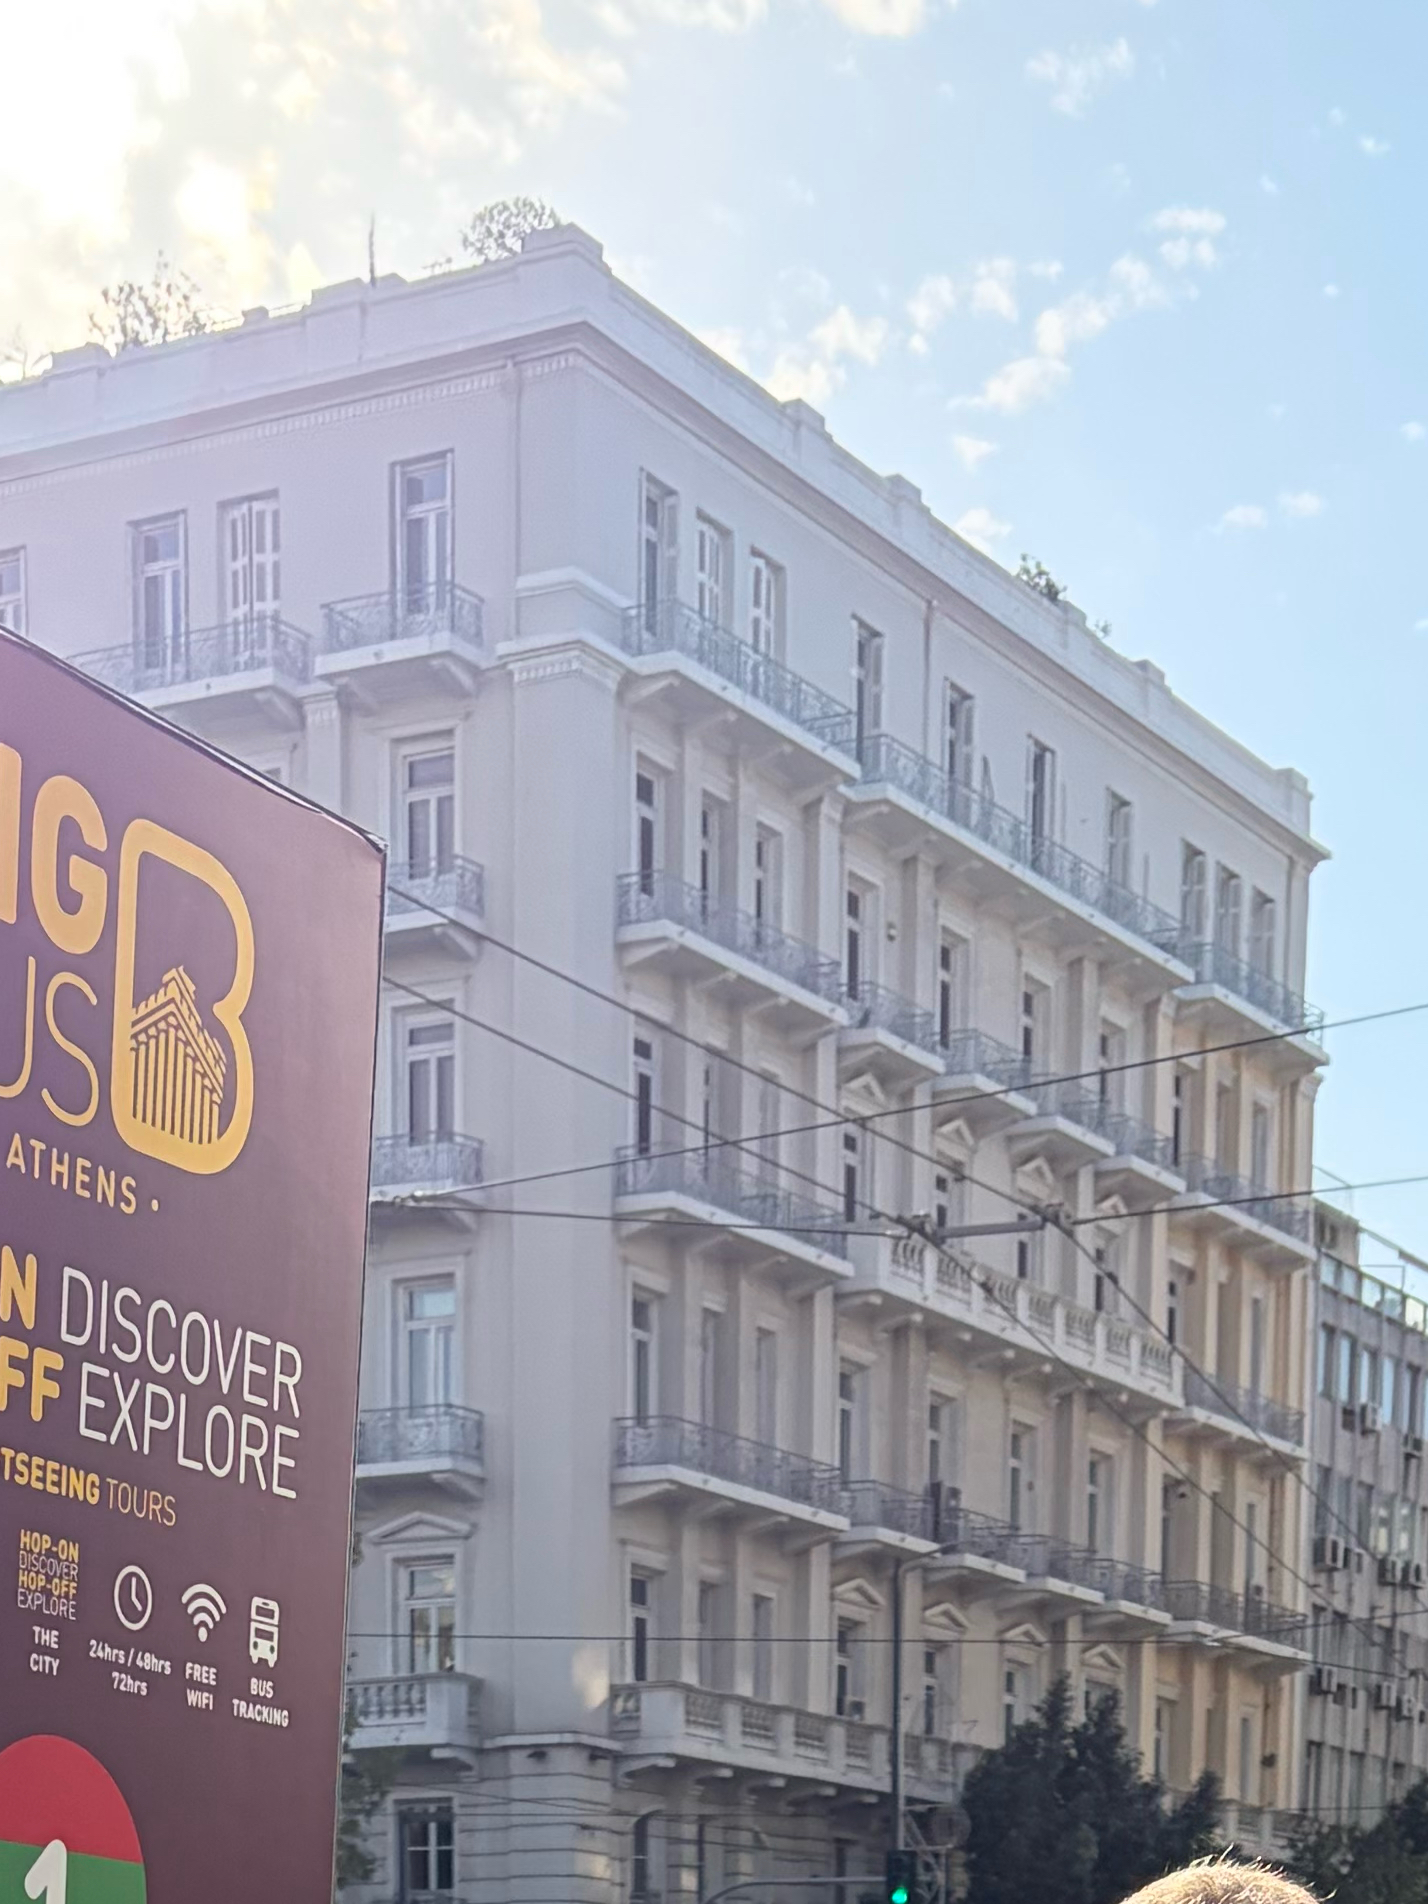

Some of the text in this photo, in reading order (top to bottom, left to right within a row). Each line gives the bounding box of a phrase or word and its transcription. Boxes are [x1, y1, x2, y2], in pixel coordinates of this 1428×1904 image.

[5, 1134, 139, 1216] ATHENS
[60, 1265, 301, 1419] DISCOVER
[78, 1360, 299, 1500] EXPLORE
[106, 1477, 177, 1527] TOURS
[19, 1528, 79, 1563] HOP-ON
[19, 1550, 78, 1581] DISCOVER
[18, 1569, 78, 1599] HOP-OFF
[17, 1588, 77, 1621] EXPLORE
[32, 1625, 60, 1650] THE
[29, 1652, 60, 1677] CITY
[88, 1639, 127, 1667] 24hrs
[135, 1649, 172, 1676] 48hrs
[111, 1671, 148, 1697] 72hrs
[184, 1661, 217, 1686] FREE
[249, 1677, 274, 1699] BUS
[186, 1687, 214, 1710] WIFI
[232, 1698, 290, 1728] TRACKING
